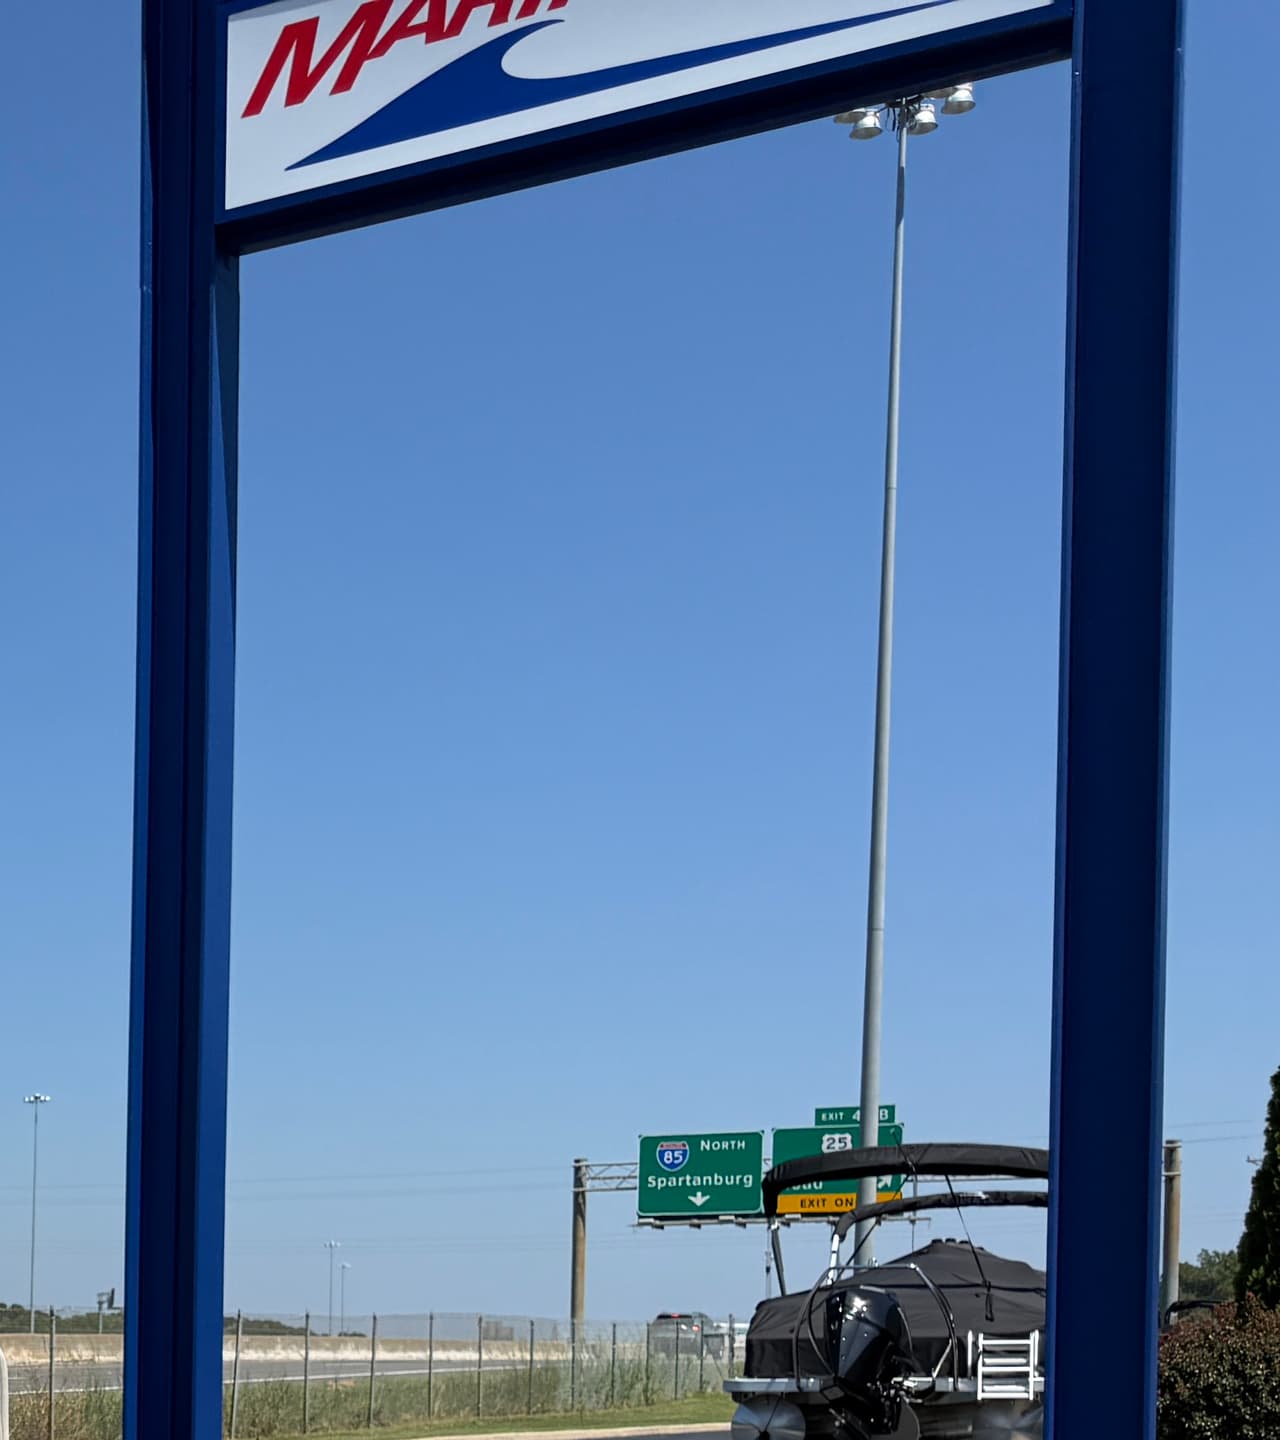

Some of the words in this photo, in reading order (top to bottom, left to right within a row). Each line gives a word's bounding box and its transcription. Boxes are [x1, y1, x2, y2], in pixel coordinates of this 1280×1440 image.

[821, 1111, 845, 1121] EXIT
[825, 1136, 848, 1150] 25
[663, 1150, 683, 1164] 85
[647, 1172, 754, 1190] Spartanburg
[800, 1199, 827, 1209] EXIT
